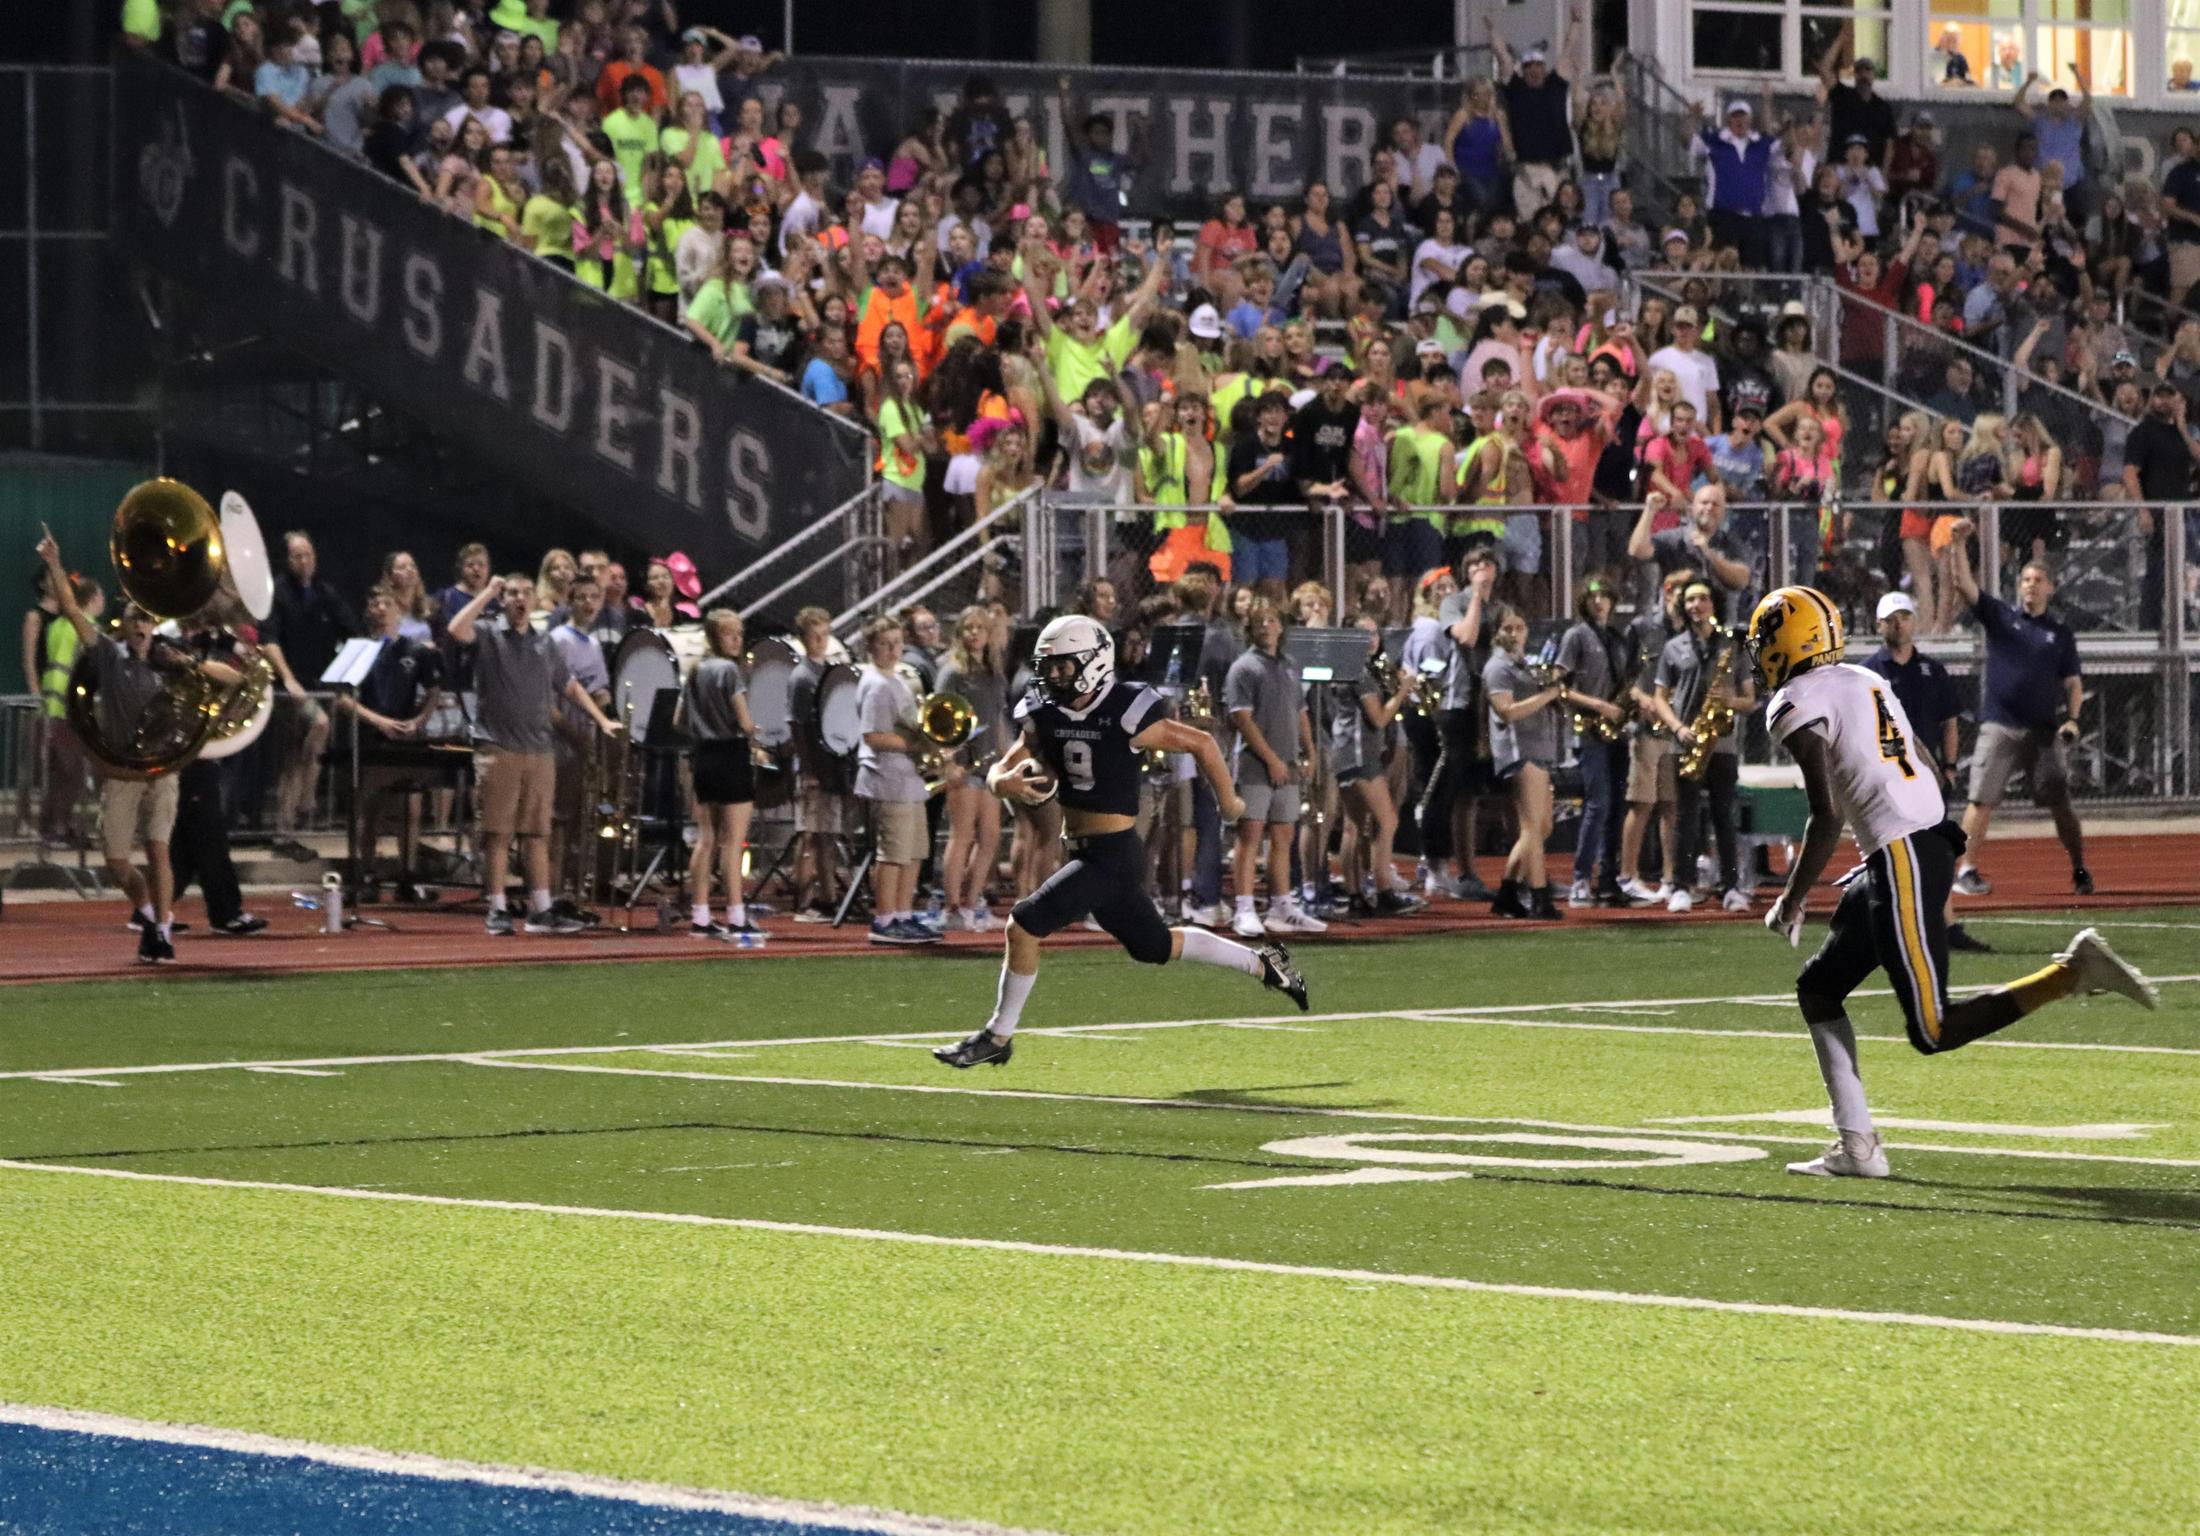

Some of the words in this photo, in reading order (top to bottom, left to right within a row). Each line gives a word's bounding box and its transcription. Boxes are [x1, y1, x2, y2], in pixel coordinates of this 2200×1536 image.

[222, 156, 772, 542] CRUSADERS
[1054, 729, 1102, 740] CRUSADERS
[1063, 740, 1096, 791] 9
[1870, 687, 1917, 780] 4
